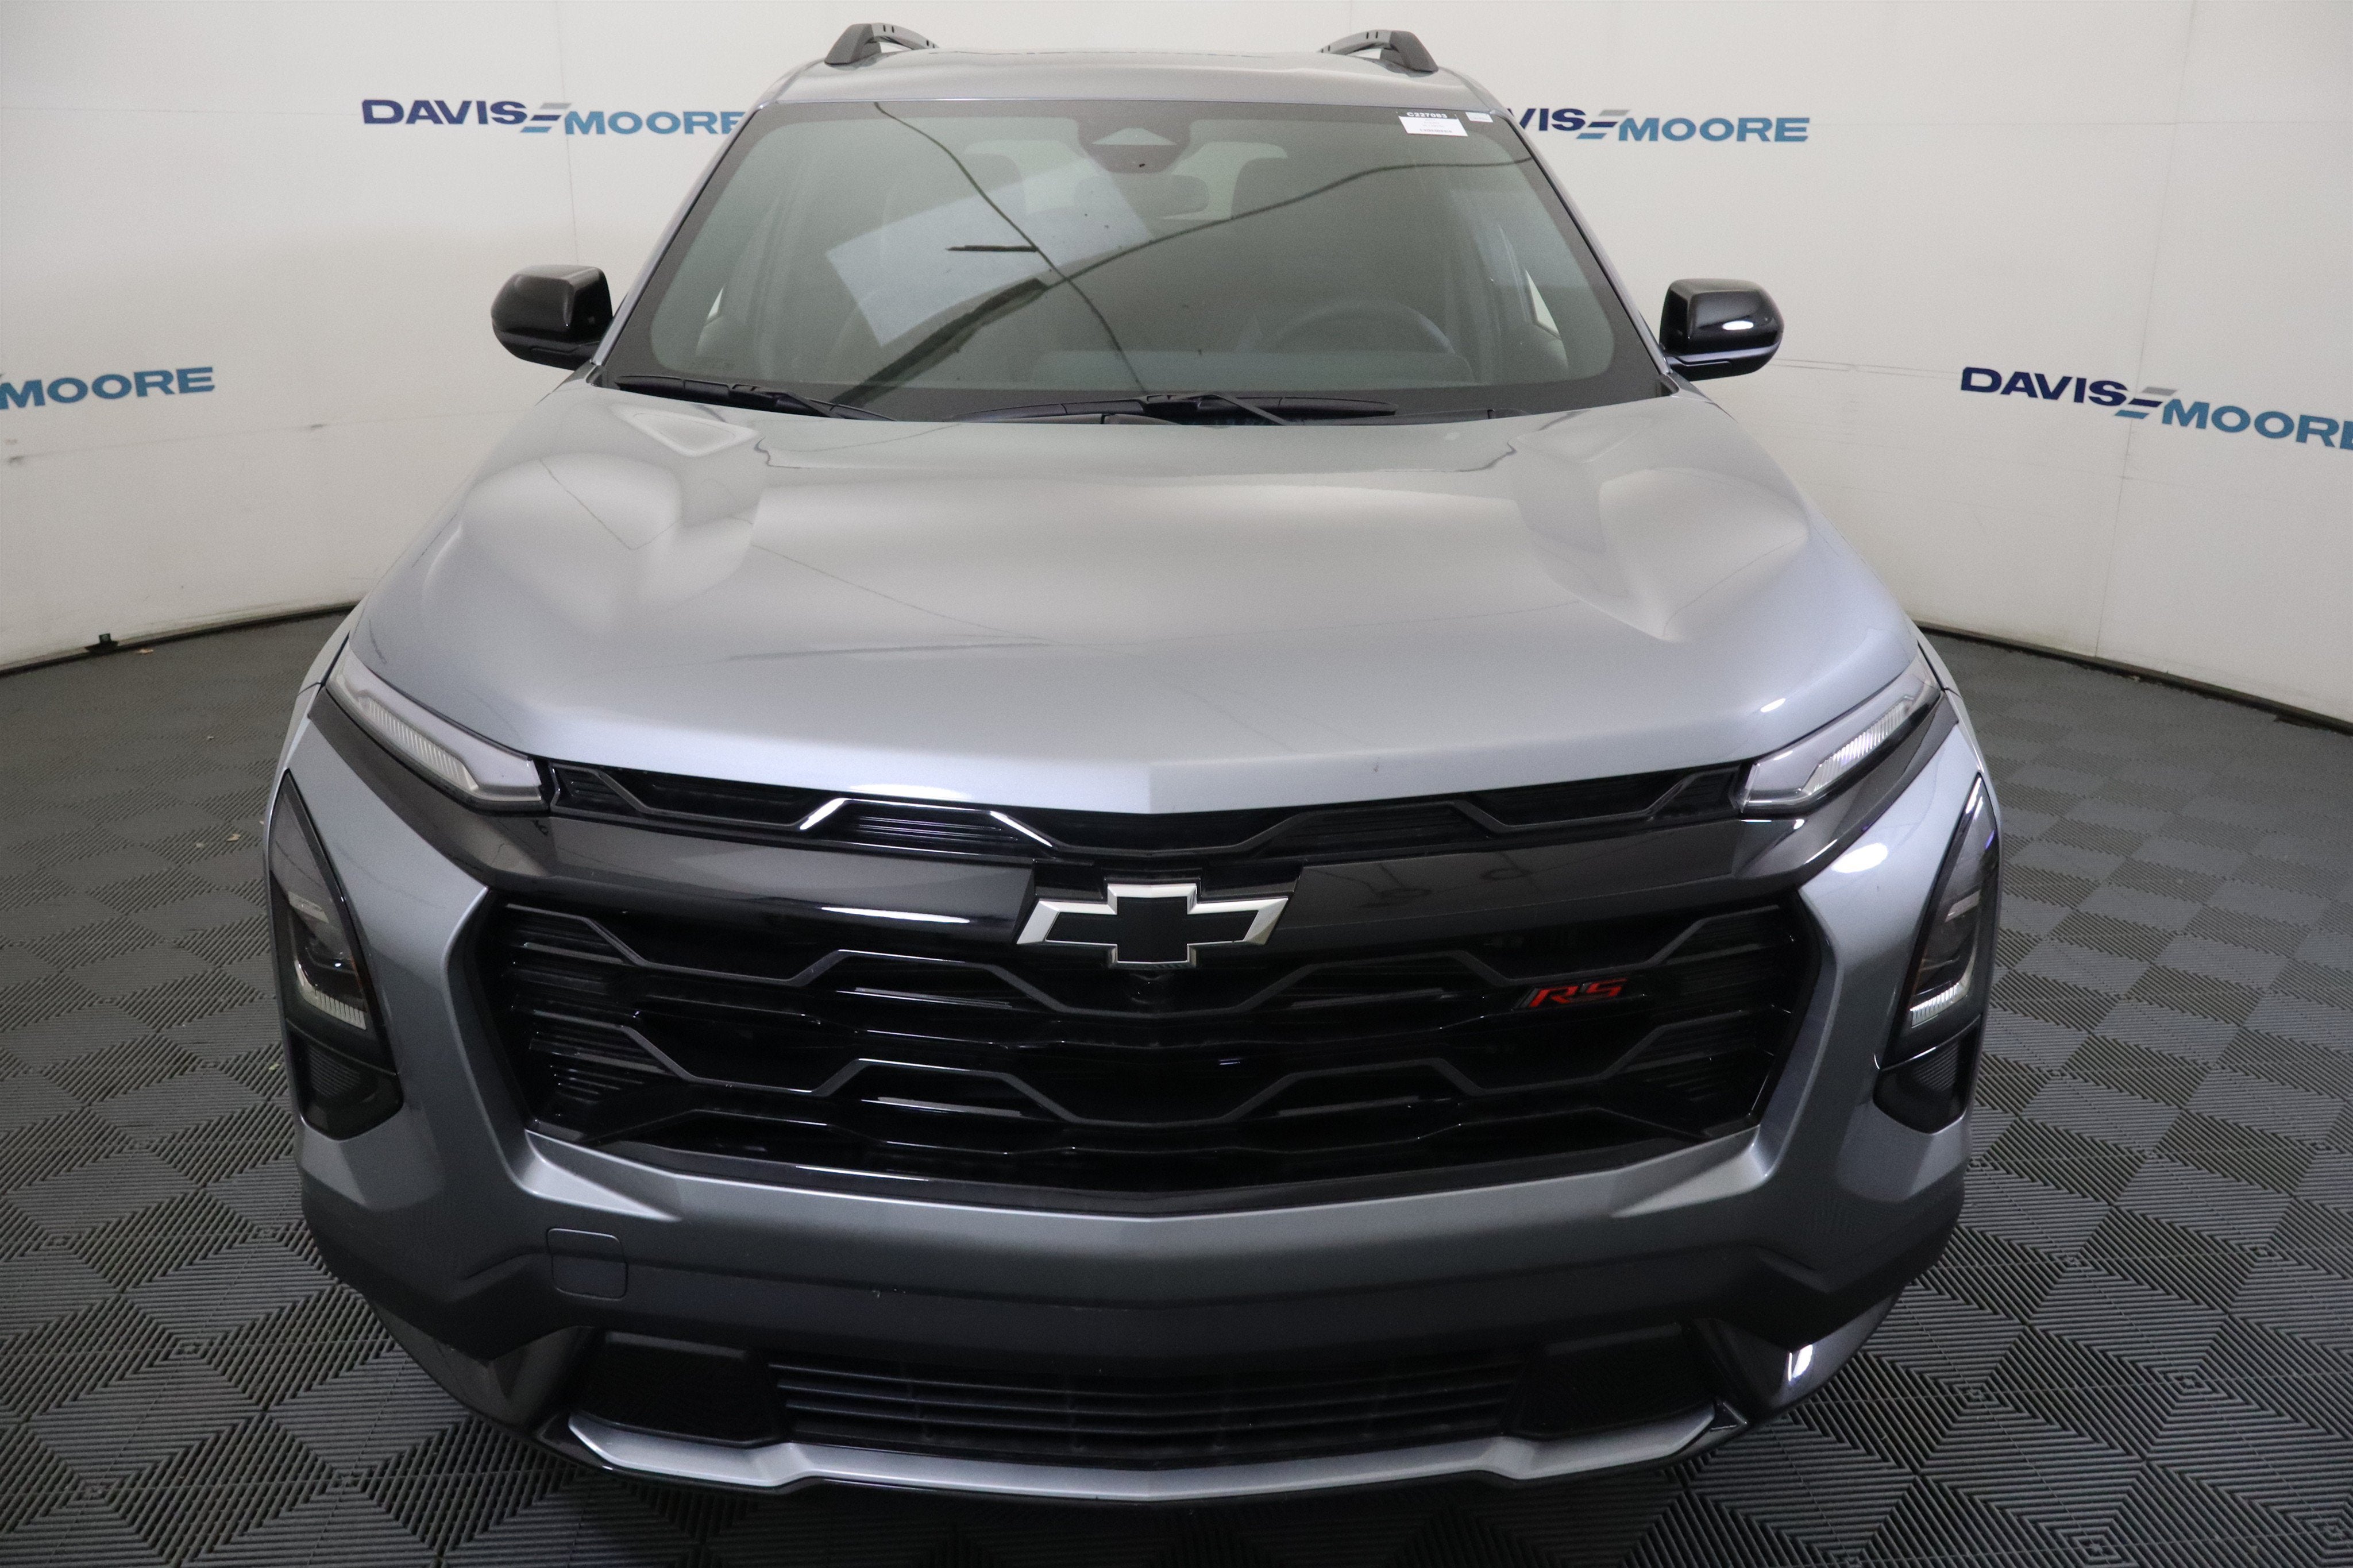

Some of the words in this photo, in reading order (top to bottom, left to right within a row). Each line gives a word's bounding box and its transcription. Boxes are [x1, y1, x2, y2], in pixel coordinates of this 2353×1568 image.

[362, 100, 527, 124] DAVIS
[1506, 108, 1586, 131] VIS
[1618, 117, 1810, 142] MOORE
[0, 367, 215, 410] MOORE
[1961, 366, 2129, 406] DAVIS
[1525, 978, 1628, 1008] RS
